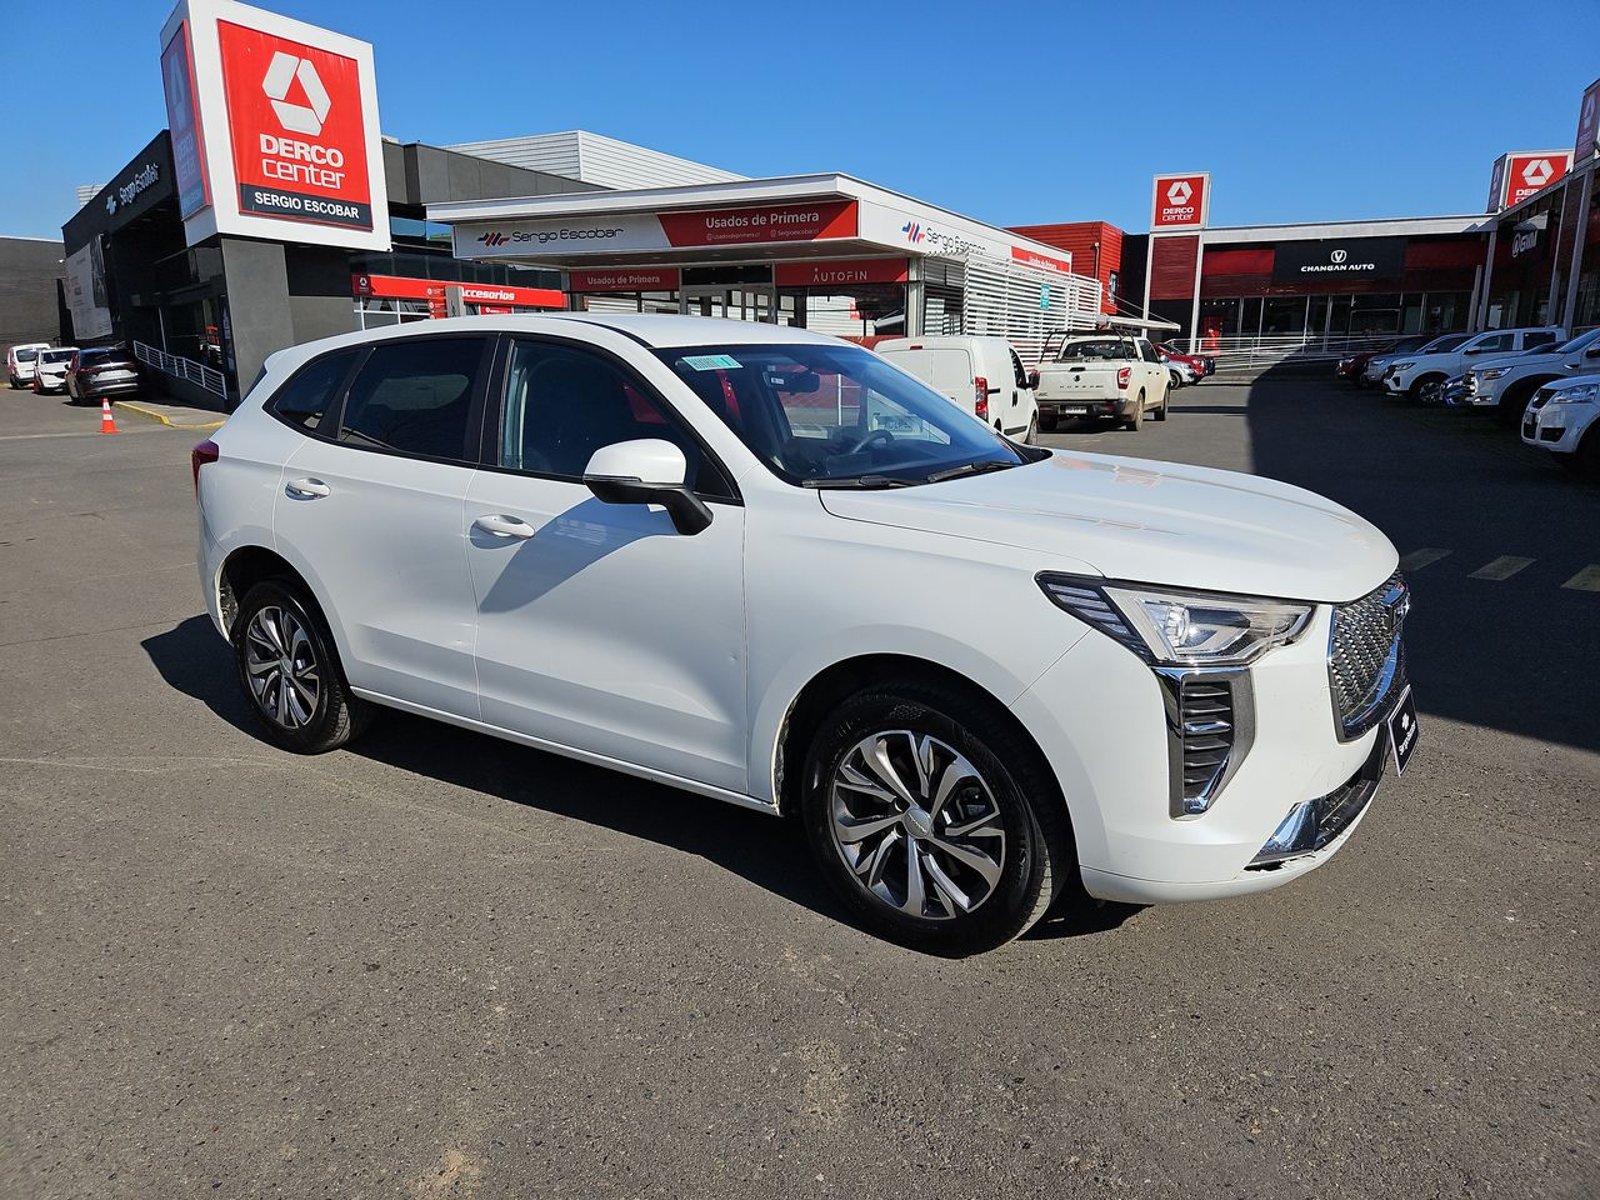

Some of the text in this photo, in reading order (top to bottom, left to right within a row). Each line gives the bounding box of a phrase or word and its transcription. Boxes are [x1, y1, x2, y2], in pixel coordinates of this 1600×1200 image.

[260, 133, 344, 168] DERCO
[262, 159, 346, 190] center
[254, 191, 360, 219] SERGIO ESCOBAR
[1163, 207, 1194, 216] DERCO
[705, 211, 820, 229] Usados de Primera
[559, 227, 624, 241] Escobar
[813, 267, 868, 283] AUTOFIN
[1300, 263, 1375, 273] CHANGAN AUTO
[587, 274, 660, 286] Usados de Primera
